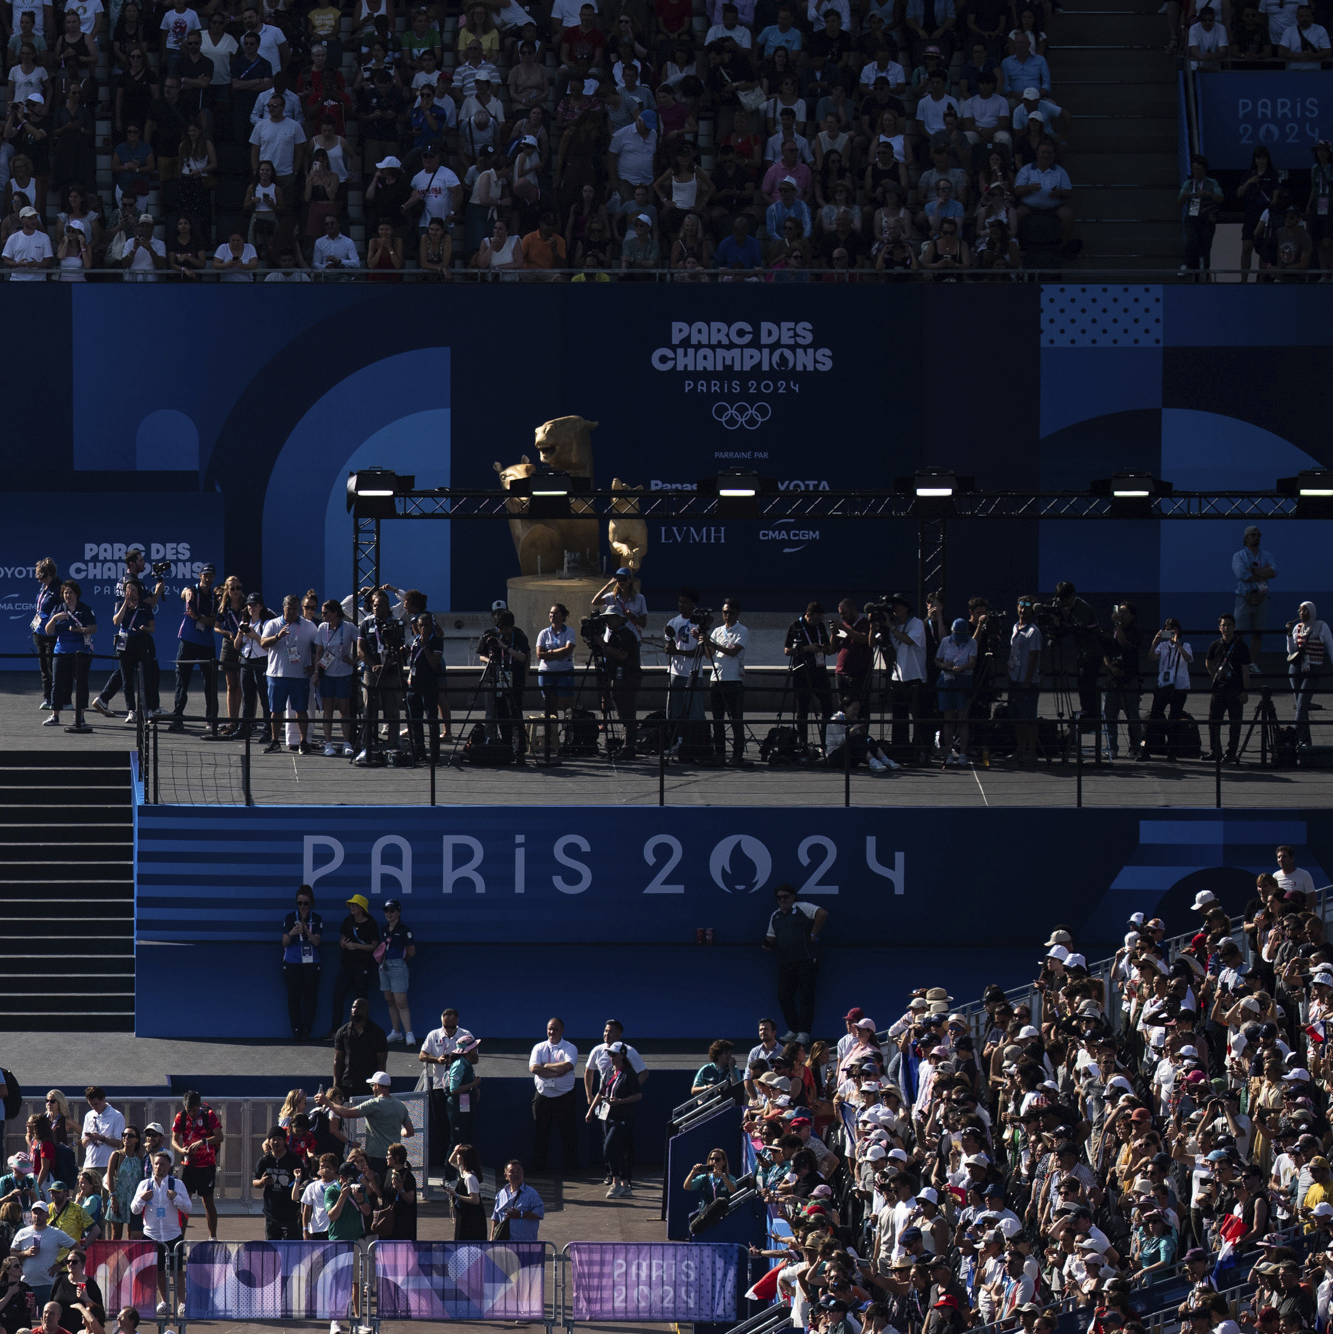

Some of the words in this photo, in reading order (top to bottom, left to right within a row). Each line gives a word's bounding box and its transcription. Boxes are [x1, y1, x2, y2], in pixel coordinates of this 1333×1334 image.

[1239, 123, 1319, 144] 2024
[671, 321, 753, 345] PARC
[760, 321, 813, 345] DES
[651, 347, 833, 372] CHAMPIONS
[748, 380, 800, 393] 2024
[714, 449, 752, 459] PARRAINÉ
[754, 451, 769, 459] PAR
[660, 526, 726, 543] LVMH
[759, 530, 789, 540] CMA
[790, 530, 820, 540] CGM
[150, 542, 191, 560] DES
[642, 834, 905, 896] 2024
[613, 1286, 696, 1308] 2024
